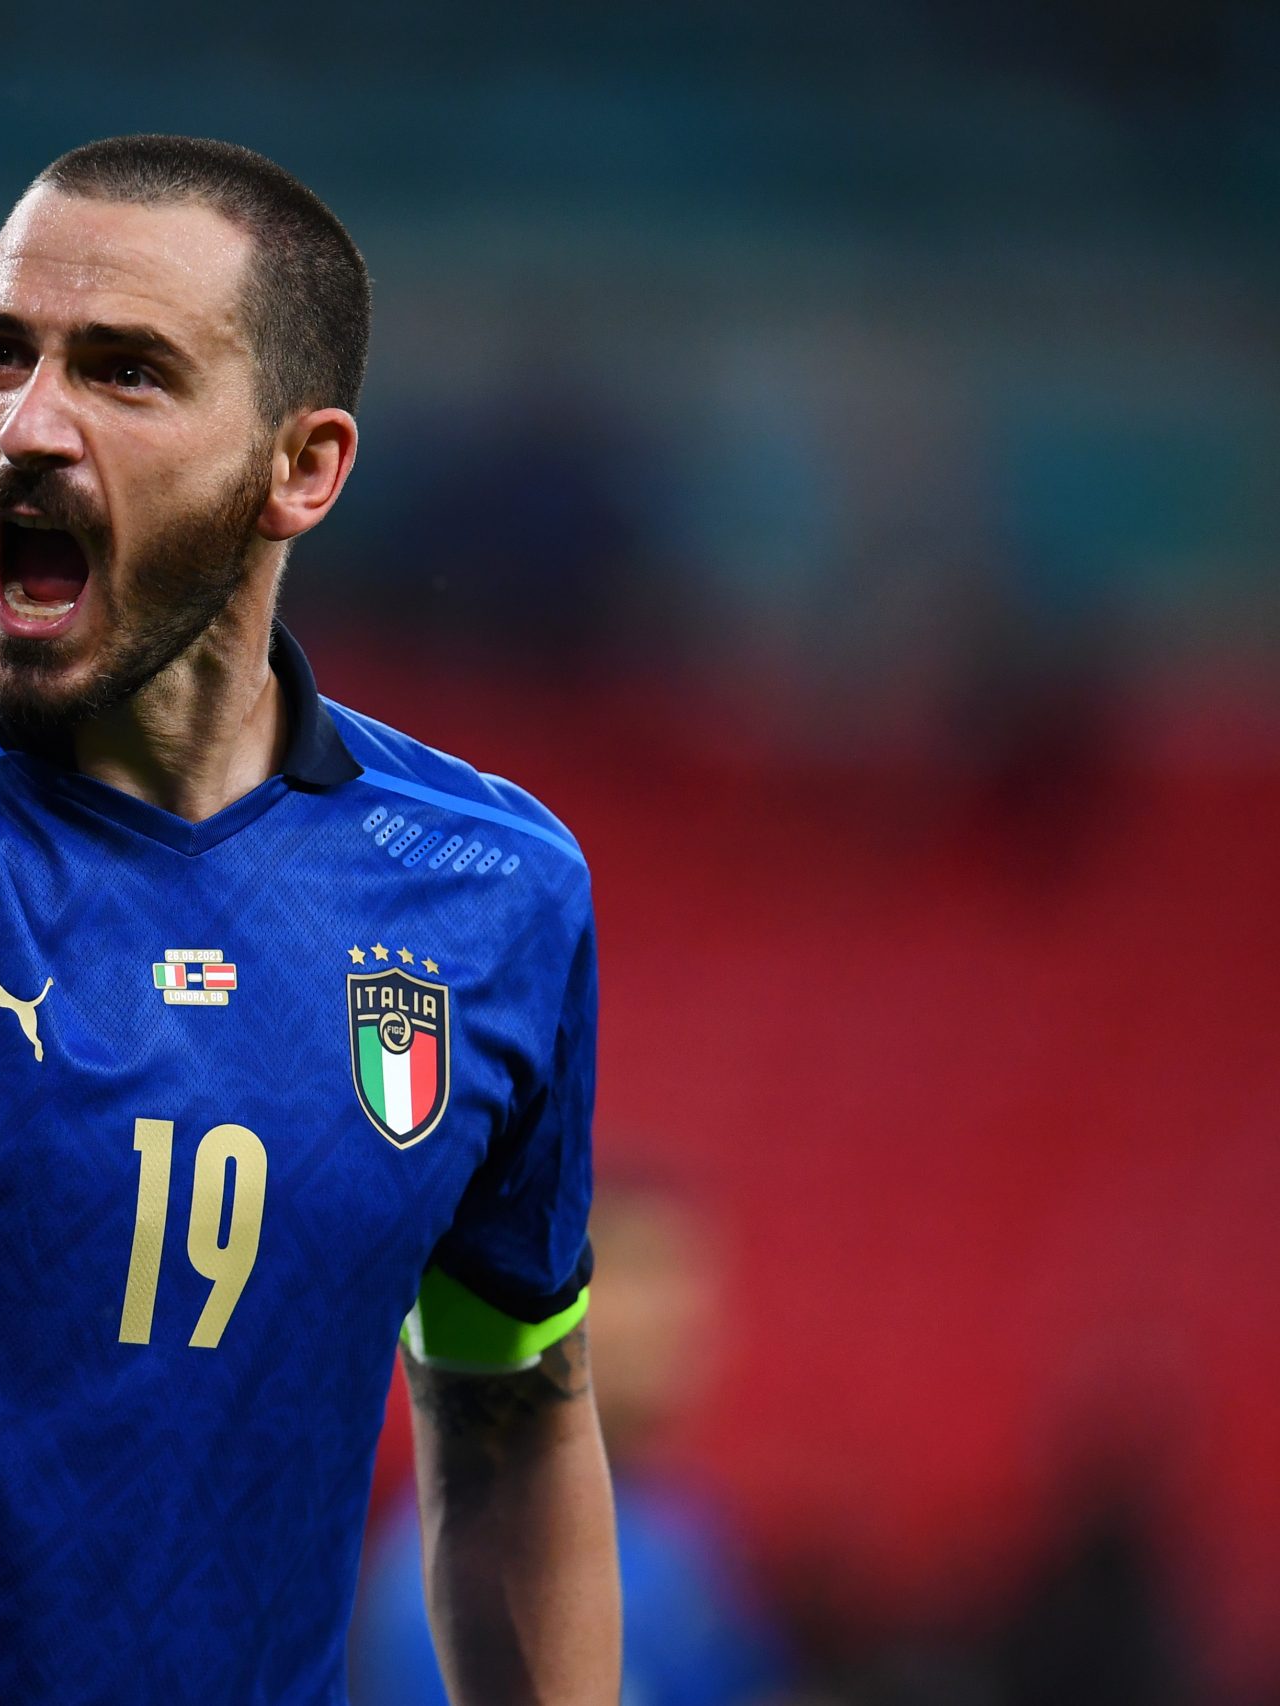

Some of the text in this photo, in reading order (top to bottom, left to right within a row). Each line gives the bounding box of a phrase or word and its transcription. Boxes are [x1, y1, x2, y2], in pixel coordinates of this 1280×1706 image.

[356, 986, 437, 1019] ITALIA
[386, 1025, 405, 1036] FIGC
[118, 1117, 268, 1350] 19
